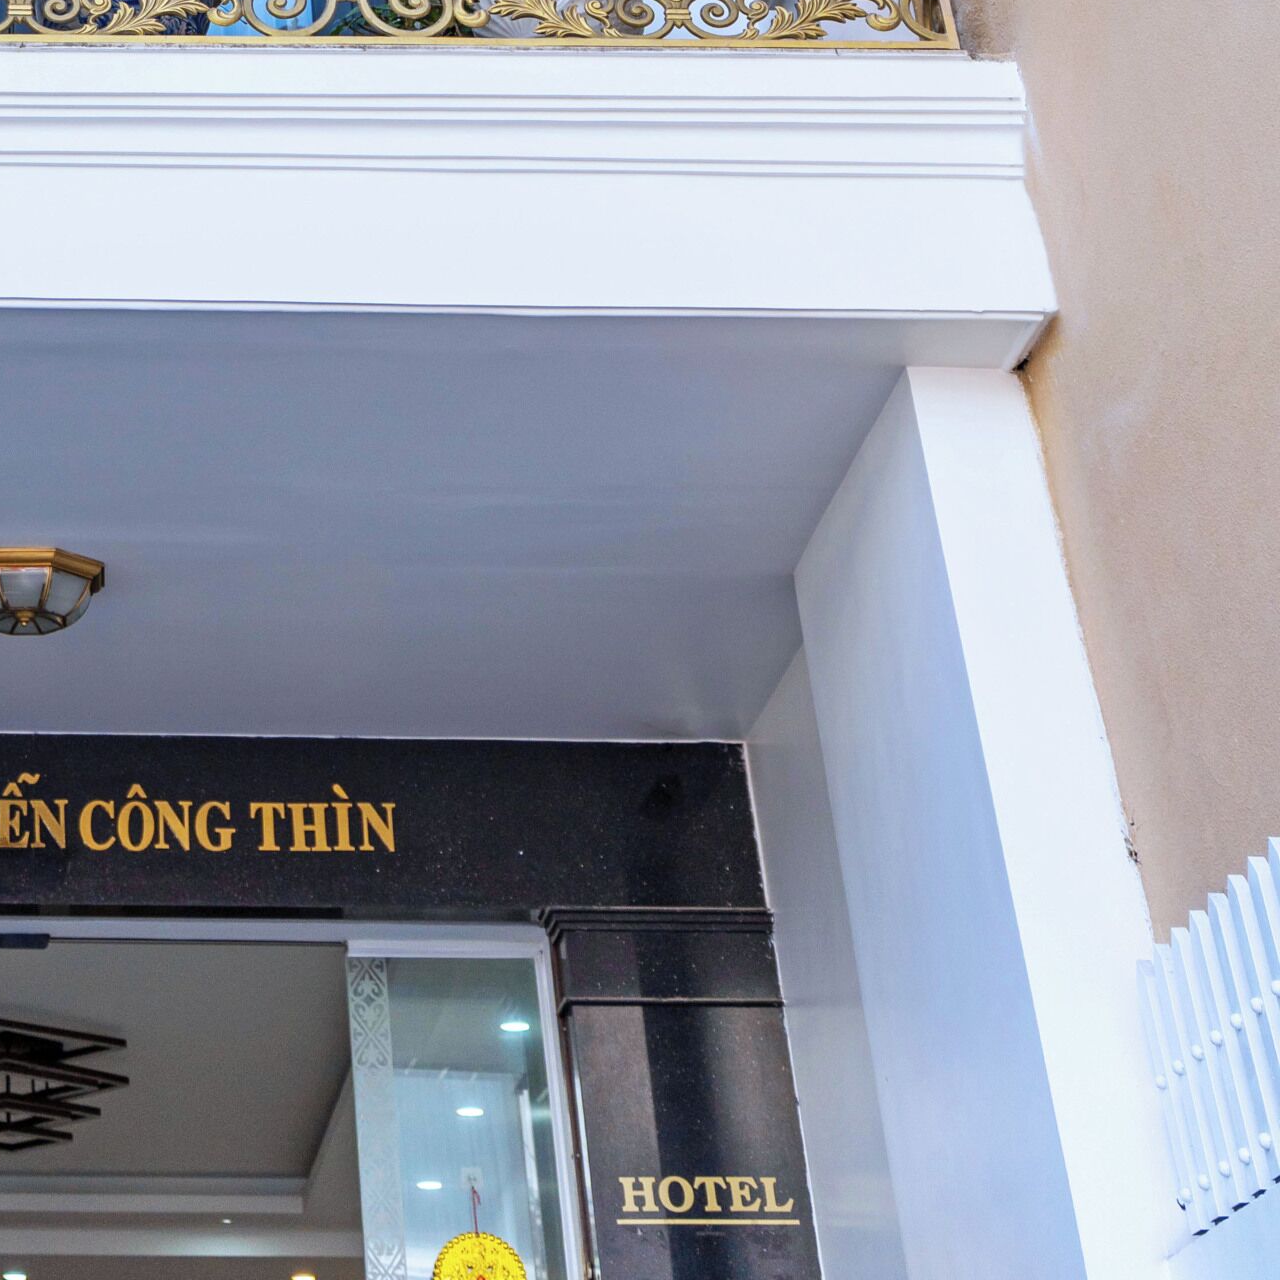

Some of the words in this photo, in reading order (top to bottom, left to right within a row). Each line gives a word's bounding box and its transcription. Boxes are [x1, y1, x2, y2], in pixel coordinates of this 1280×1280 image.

[79, 783, 237, 852] CÔNG
[250, 783, 397, 853] THÌN
[618, 1175, 795, 1213] HOTEL
